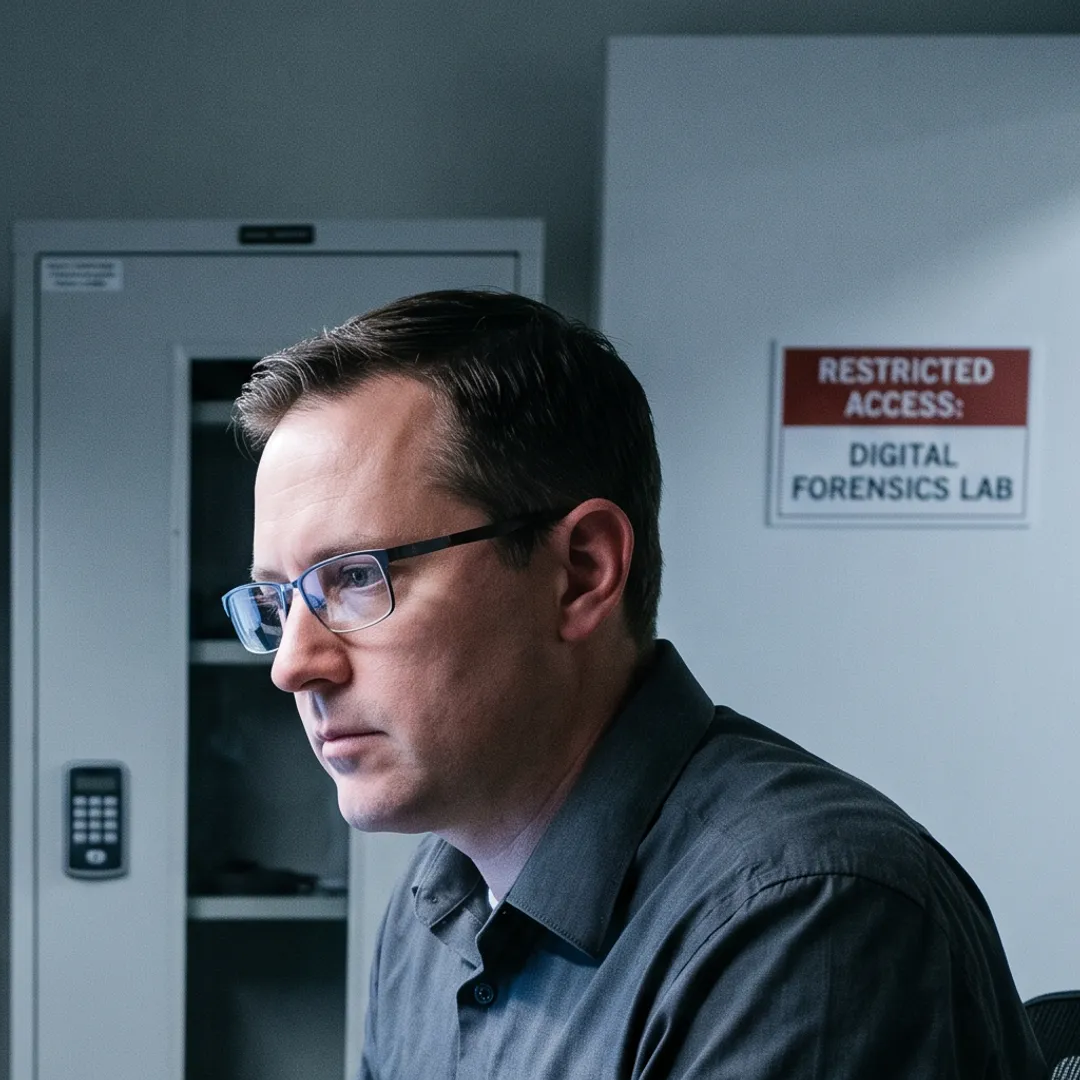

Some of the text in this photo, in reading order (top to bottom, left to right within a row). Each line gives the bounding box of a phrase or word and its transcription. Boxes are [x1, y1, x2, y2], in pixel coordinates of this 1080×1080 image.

[818, 356, 995, 385] RESTRICTED
[844, 390, 965, 419] ACCESS:
[849, 442, 958, 468] DIGITAL
[791, 474, 1014, 501] FORENSICS LAB
